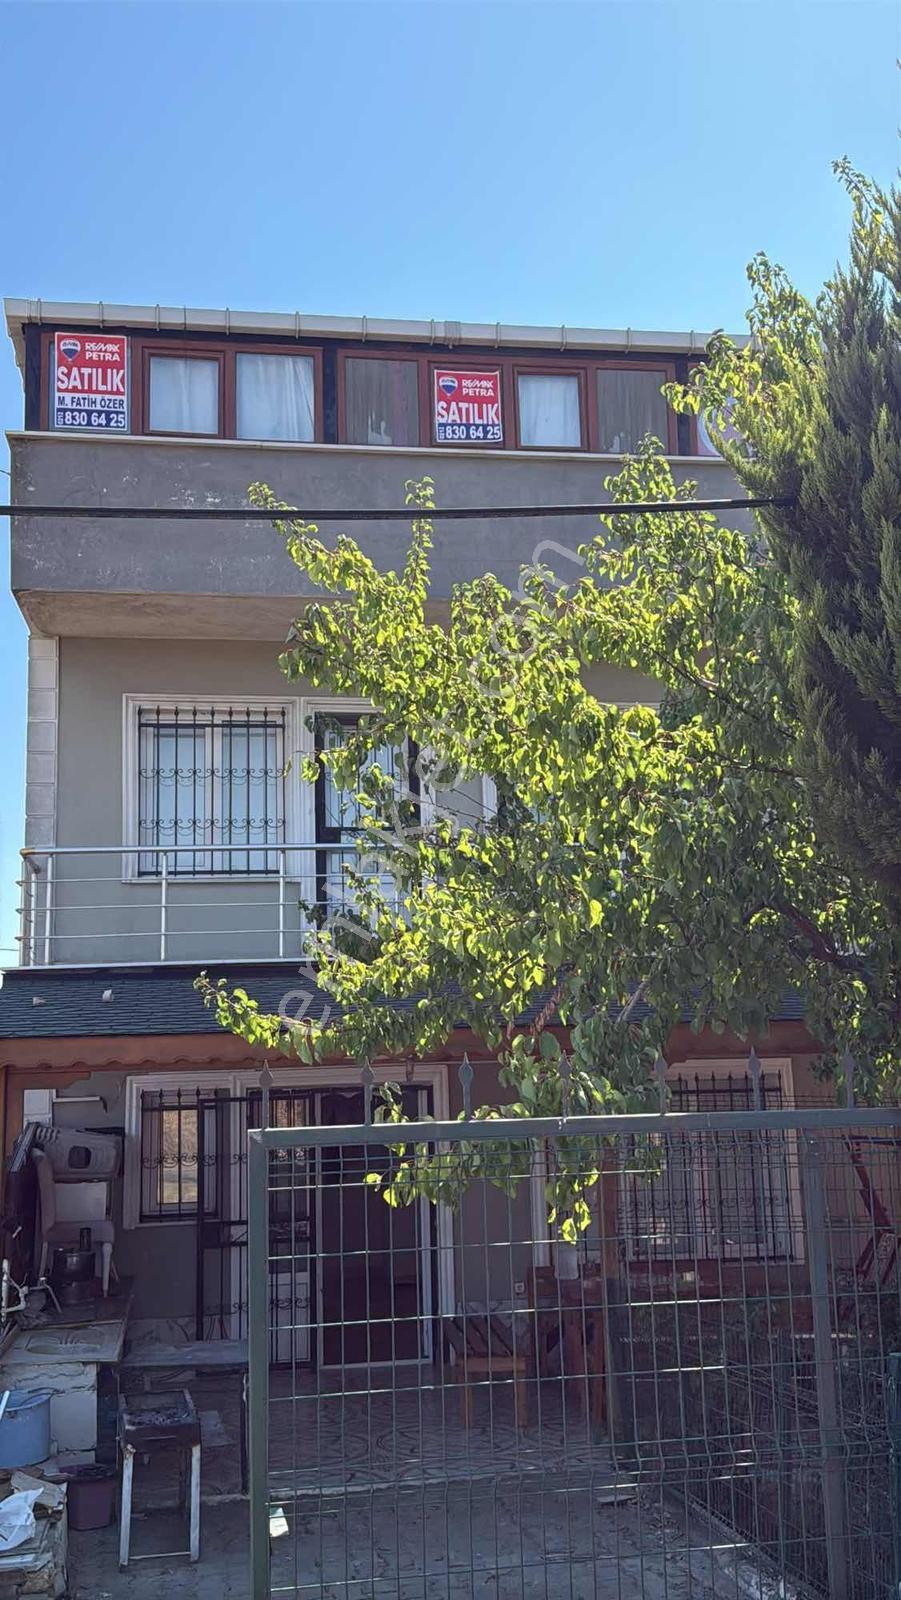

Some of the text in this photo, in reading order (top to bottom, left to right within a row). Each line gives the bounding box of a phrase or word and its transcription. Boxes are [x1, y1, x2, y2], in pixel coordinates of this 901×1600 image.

[85, 352, 120, 361] PETRA
[57, 366, 125, 392] SATILIK
[462, 388, 495, 396] PETRA
[58, 395, 125, 409] M. FATİH ÖZER
[64, 411, 87, 425] 830
[91, 412, 106, 426] 64
[110, 413, 125, 426] 25
[437, 401, 499, 424] SATILIK
[445, 425, 466, 439] 830
[469, 426, 484, 439] 64
[487, 426, 500, 439] 25
